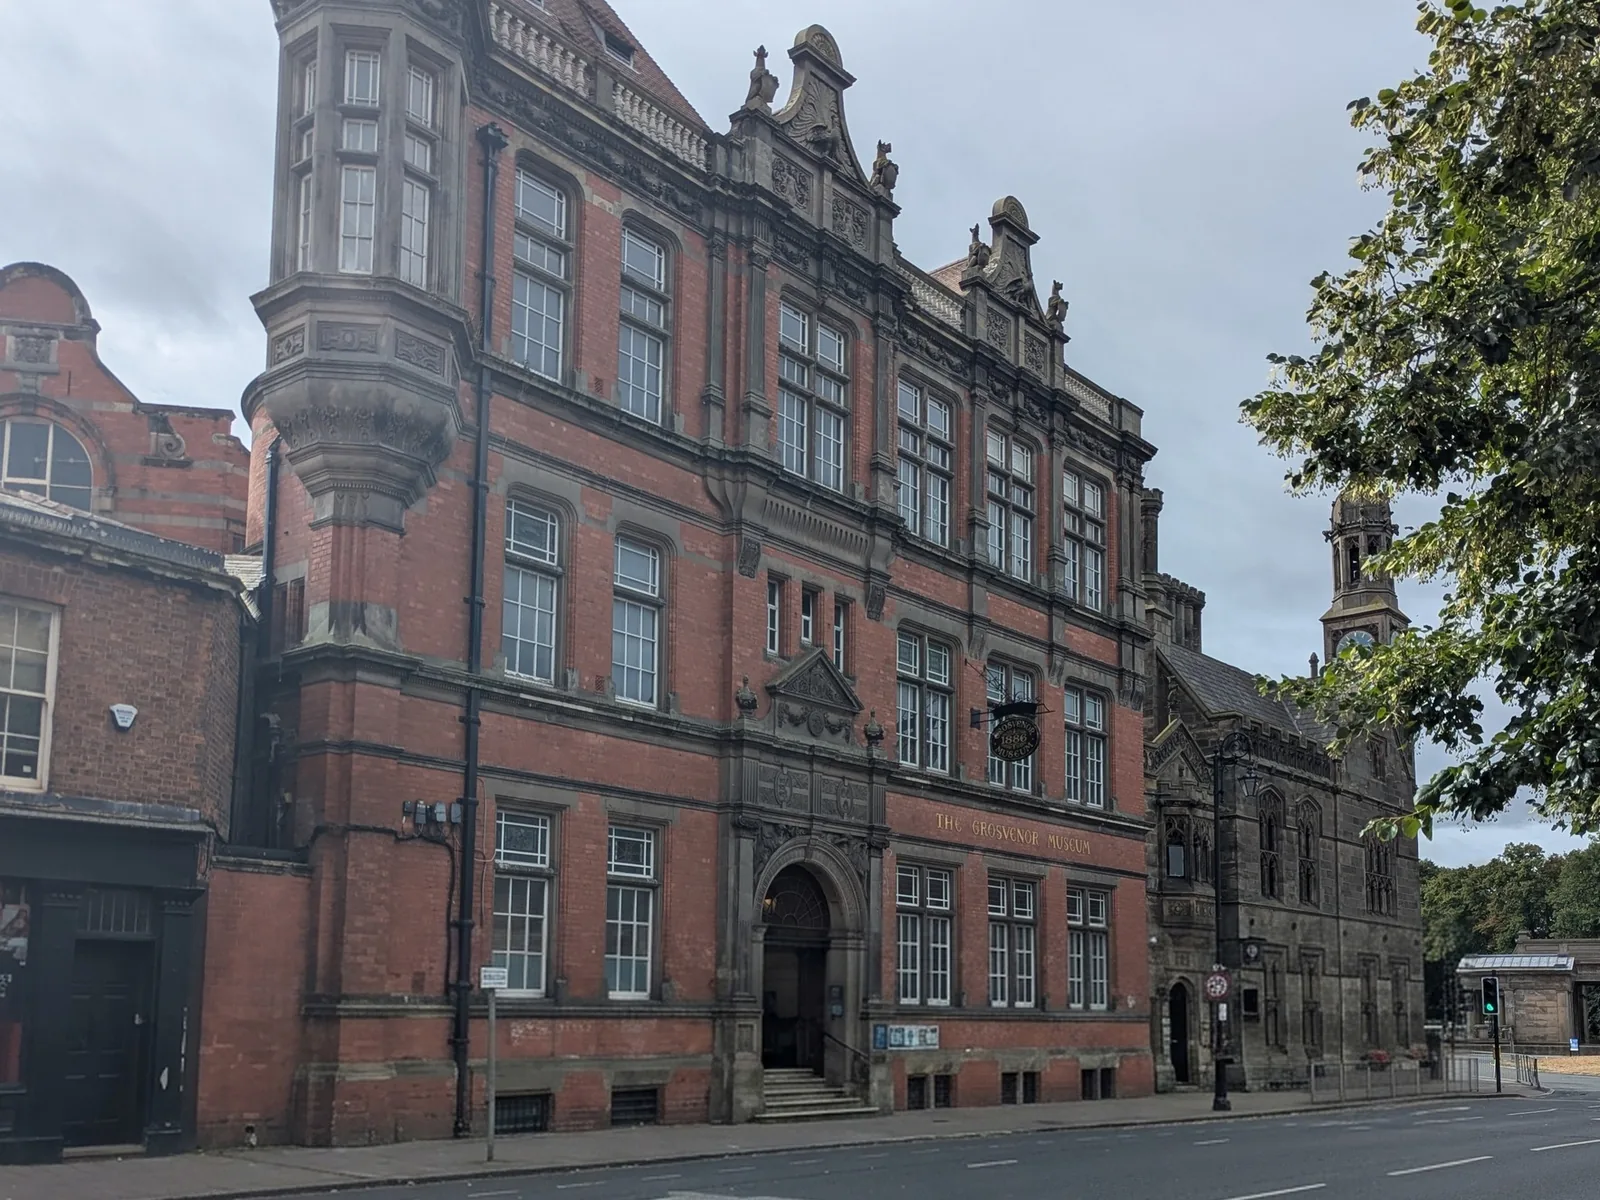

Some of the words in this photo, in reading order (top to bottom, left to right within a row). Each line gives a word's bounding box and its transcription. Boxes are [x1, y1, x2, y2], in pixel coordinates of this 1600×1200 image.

[1001, 733, 1027, 745] 1886
[995, 742, 1034, 758] MUSEUM
[936, 812, 962, 832] THE
[972, 819, 1039, 846] GROSVENOR
[1048, 833, 1091, 855] MUSEUM
